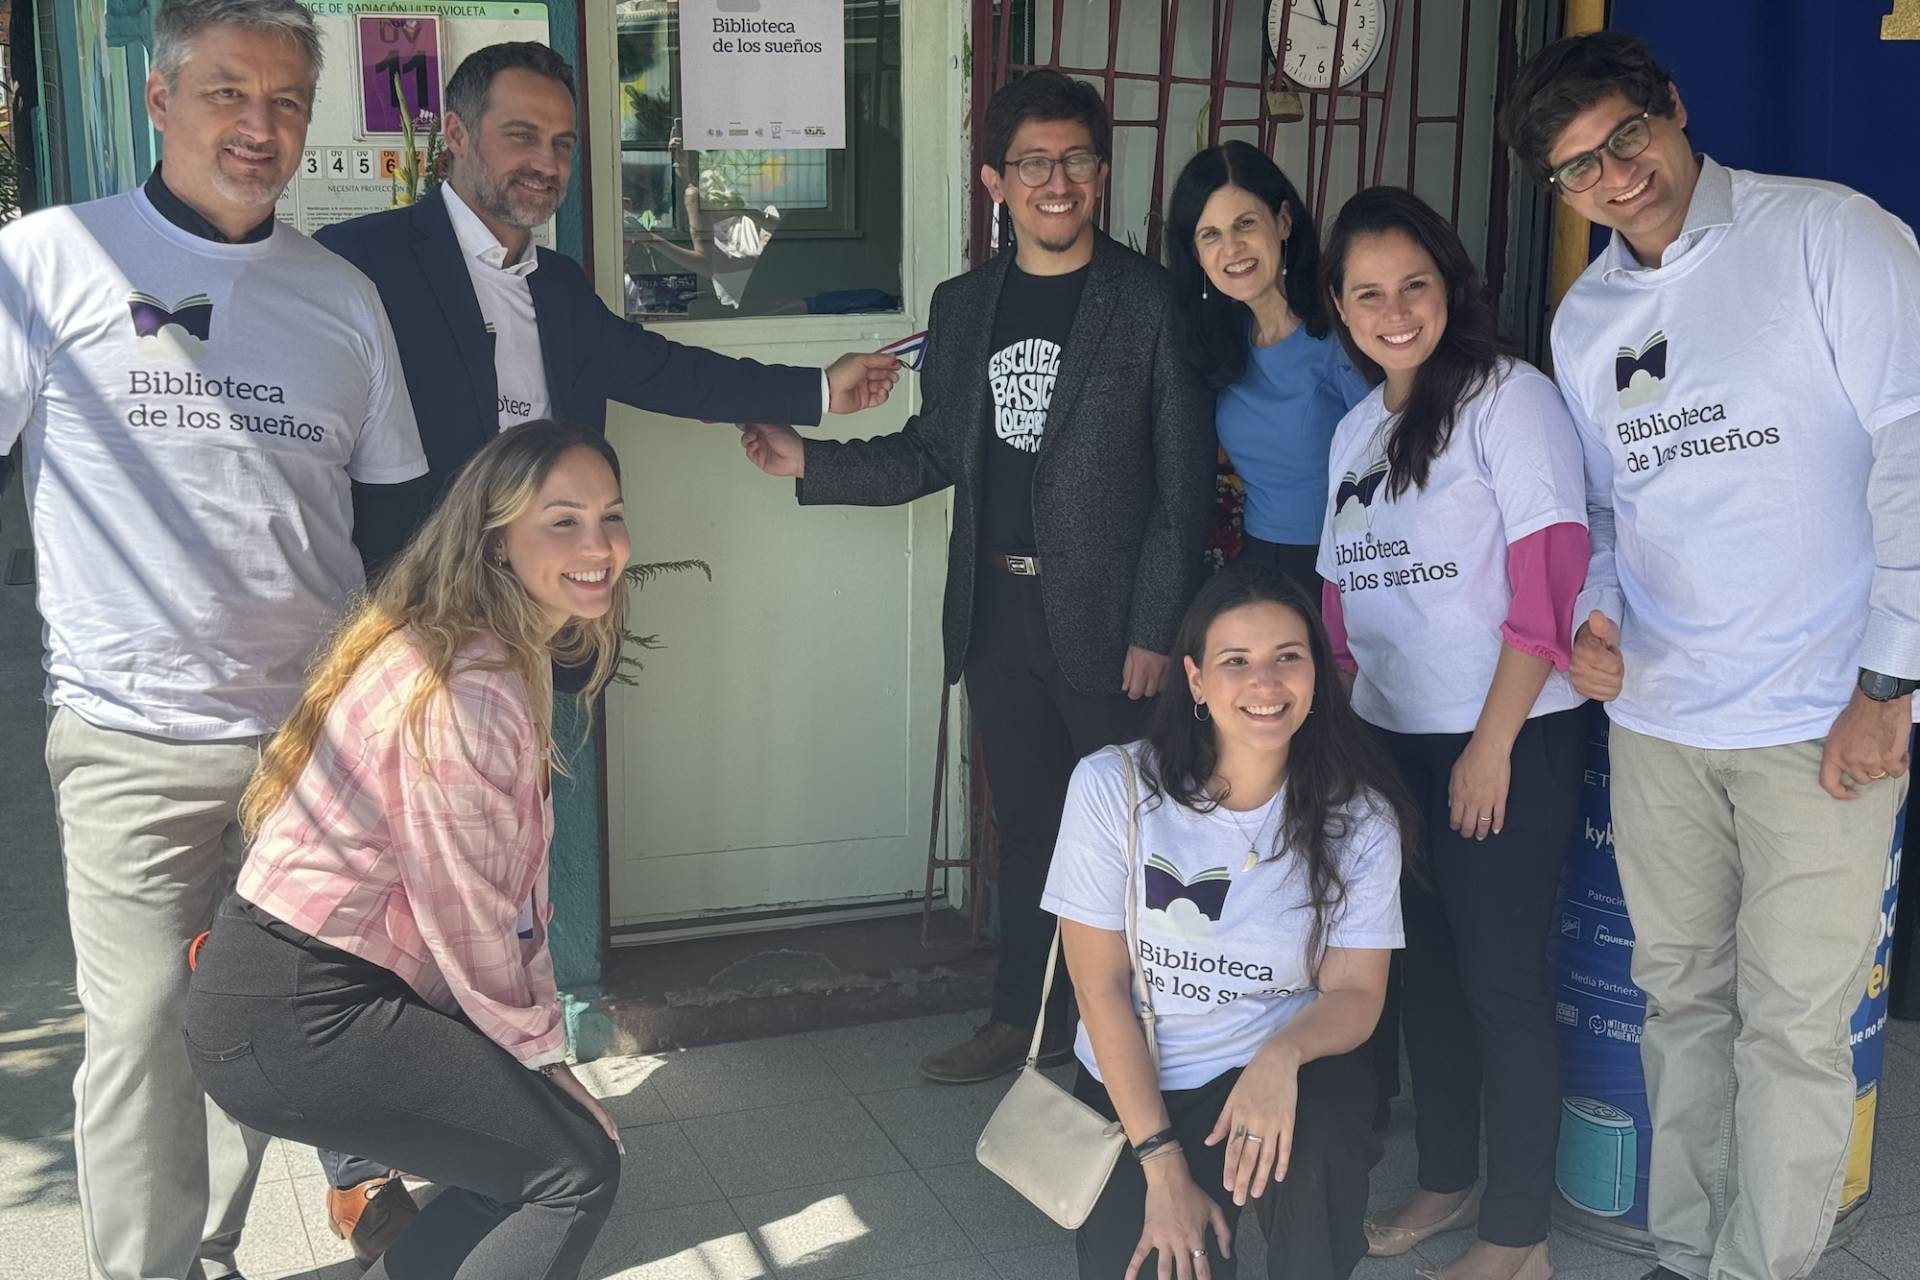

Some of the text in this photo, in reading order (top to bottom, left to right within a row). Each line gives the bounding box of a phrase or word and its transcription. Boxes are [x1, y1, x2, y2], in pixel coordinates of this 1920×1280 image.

[328, 4, 343, 14] DE
[712, 18, 796, 34] Biblioteca
[713, 38, 823, 53] de los sueños
[375, 50, 429, 108] 11
[307, 158, 318, 173] 3
[333, 157, 344, 173] 4
[360, 158, 370, 174] 5
[386, 159, 396, 174] 6
[129, 370, 285, 404] Biblioteca
[128, 404, 325, 442] de los sueños
[1616, 403, 1727, 445] Biblioteca
[1627, 428, 1781, 473] de los sueños
[1349, 571, 1378, 591] los
[1384, 562, 1458, 587] sueños
[1139, 939, 1273, 982] Biblioteca
[1144, 968, 1165, 992] de
[1172, 976, 1211, 1002] los
[1570, 970, 1639, 998] Media Partners
